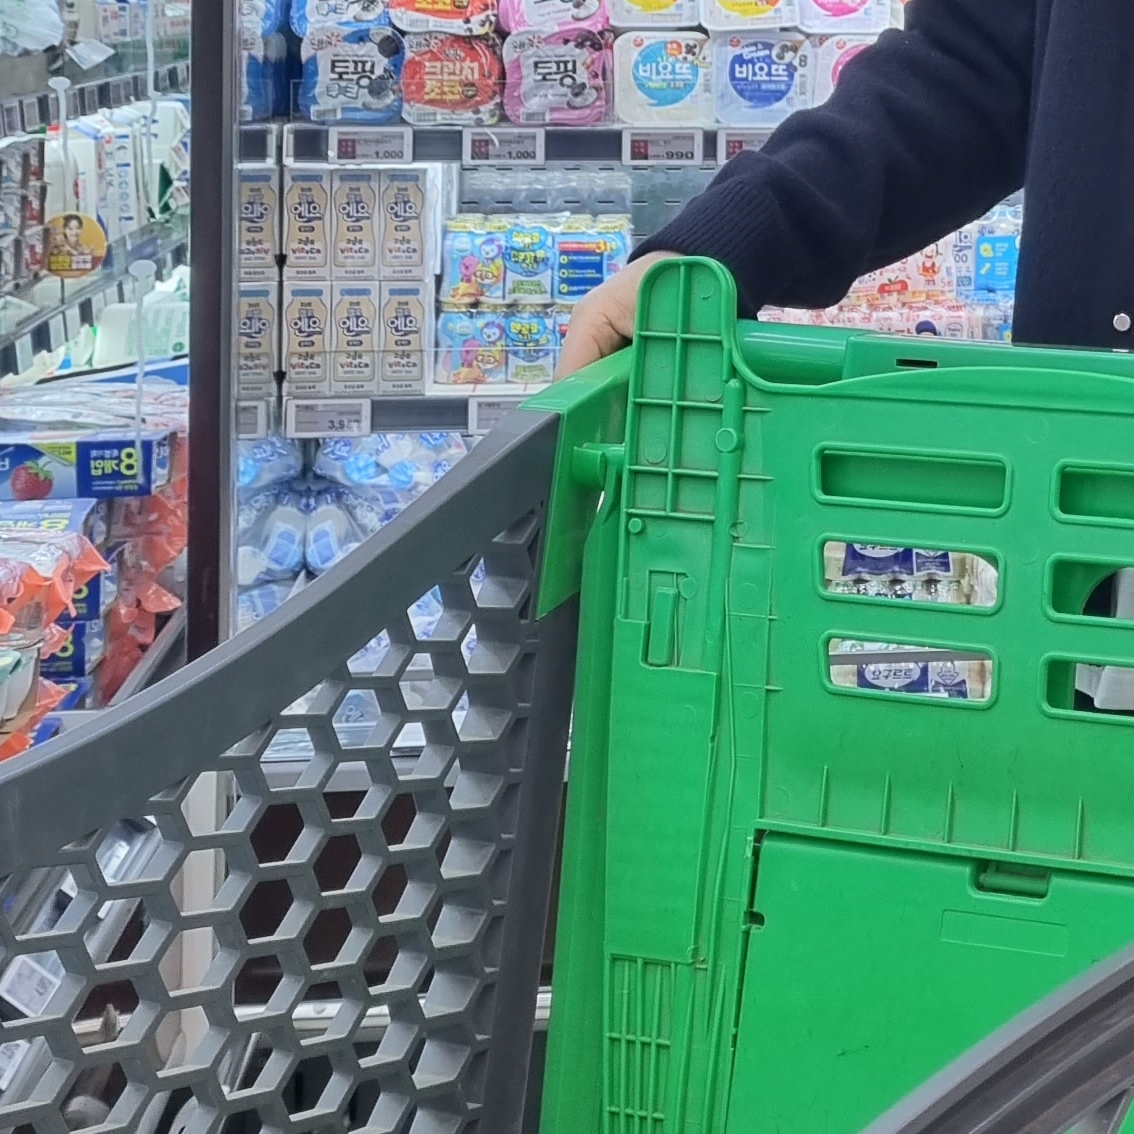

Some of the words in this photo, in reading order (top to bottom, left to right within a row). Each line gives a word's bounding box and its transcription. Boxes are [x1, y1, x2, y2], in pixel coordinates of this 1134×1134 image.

[330, 59, 377, 89] 토핑
[424, 61, 480, 80] 크런치
[533, 59, 578, 88] 토핑
[639, 59, 693, 80] 비요뜨
[735, 61, 788, 81] 비요뜨
[374, 150, 404, 159] 1,000
[507, 151, 536, 159] 1,000
[664, 151, 694, 159] 990
